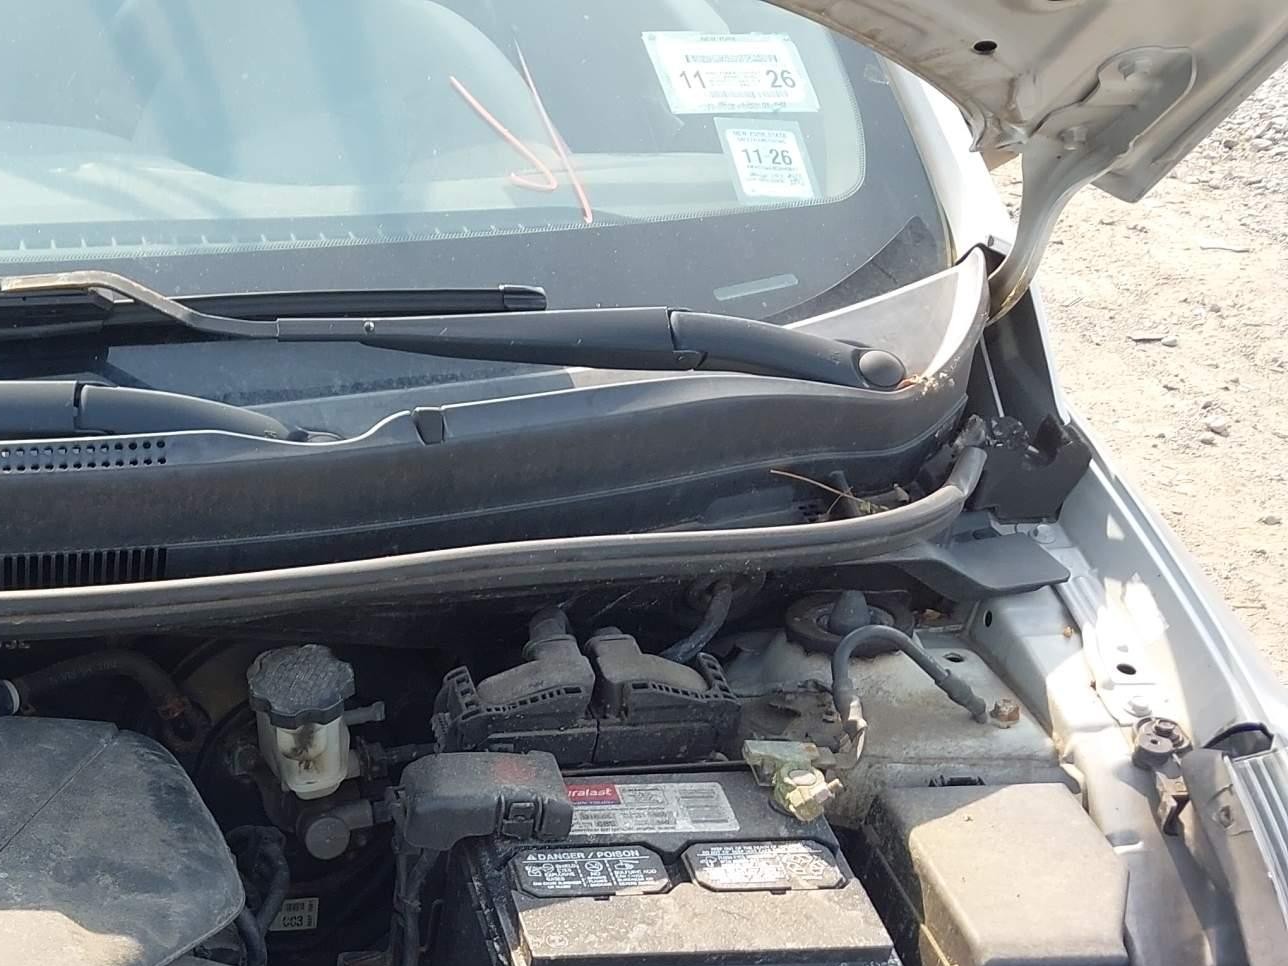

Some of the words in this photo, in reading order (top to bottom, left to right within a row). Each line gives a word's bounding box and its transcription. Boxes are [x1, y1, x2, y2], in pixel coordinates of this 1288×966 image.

[680, 70, 706, 89] 11
[765, 69, 797, 89] 26
[538, 852, 585, 861] DANGER
[596, 850, 639, 859] POISON
